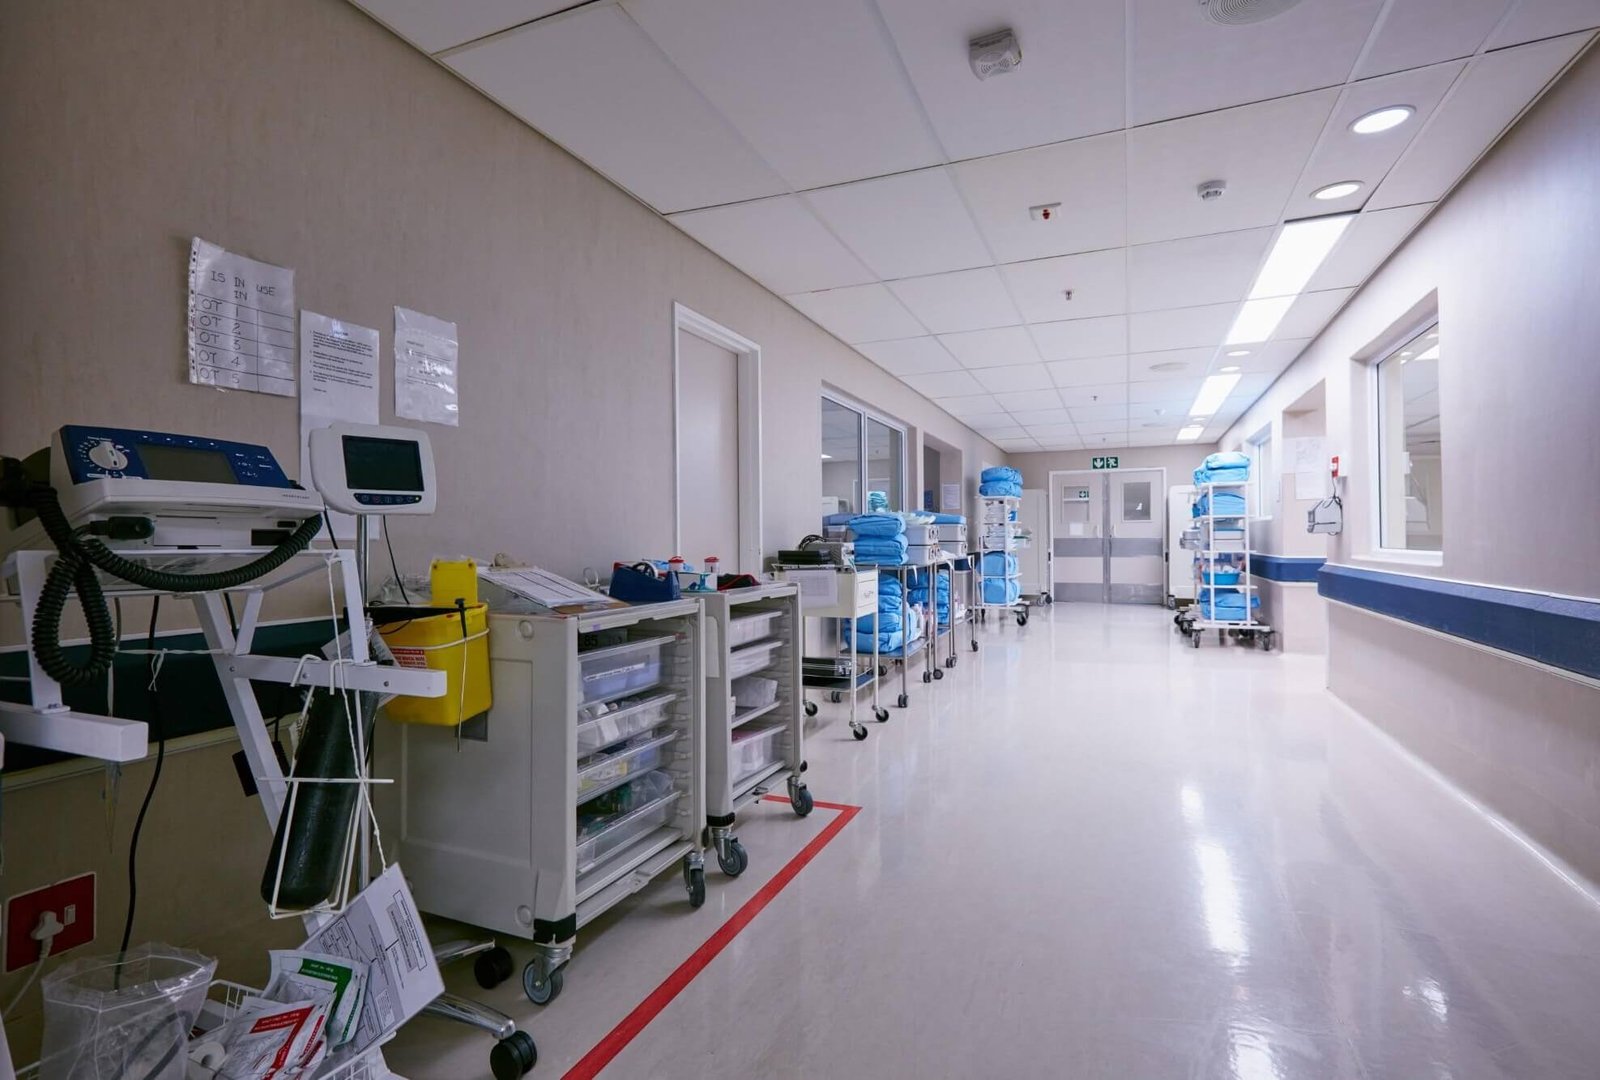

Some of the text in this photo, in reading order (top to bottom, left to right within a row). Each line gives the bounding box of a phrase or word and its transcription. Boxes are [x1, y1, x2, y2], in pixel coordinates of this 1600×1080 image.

[211, 270, 276, 296] IS IN USE
[201, 298, 222, 311] OT
[200, 315, 241, 335] OT 2
[200, 331, 241, 350] OT 3
[199, 350, 240, 367] OT 4
[200, 367, 240, 384] OT 5
